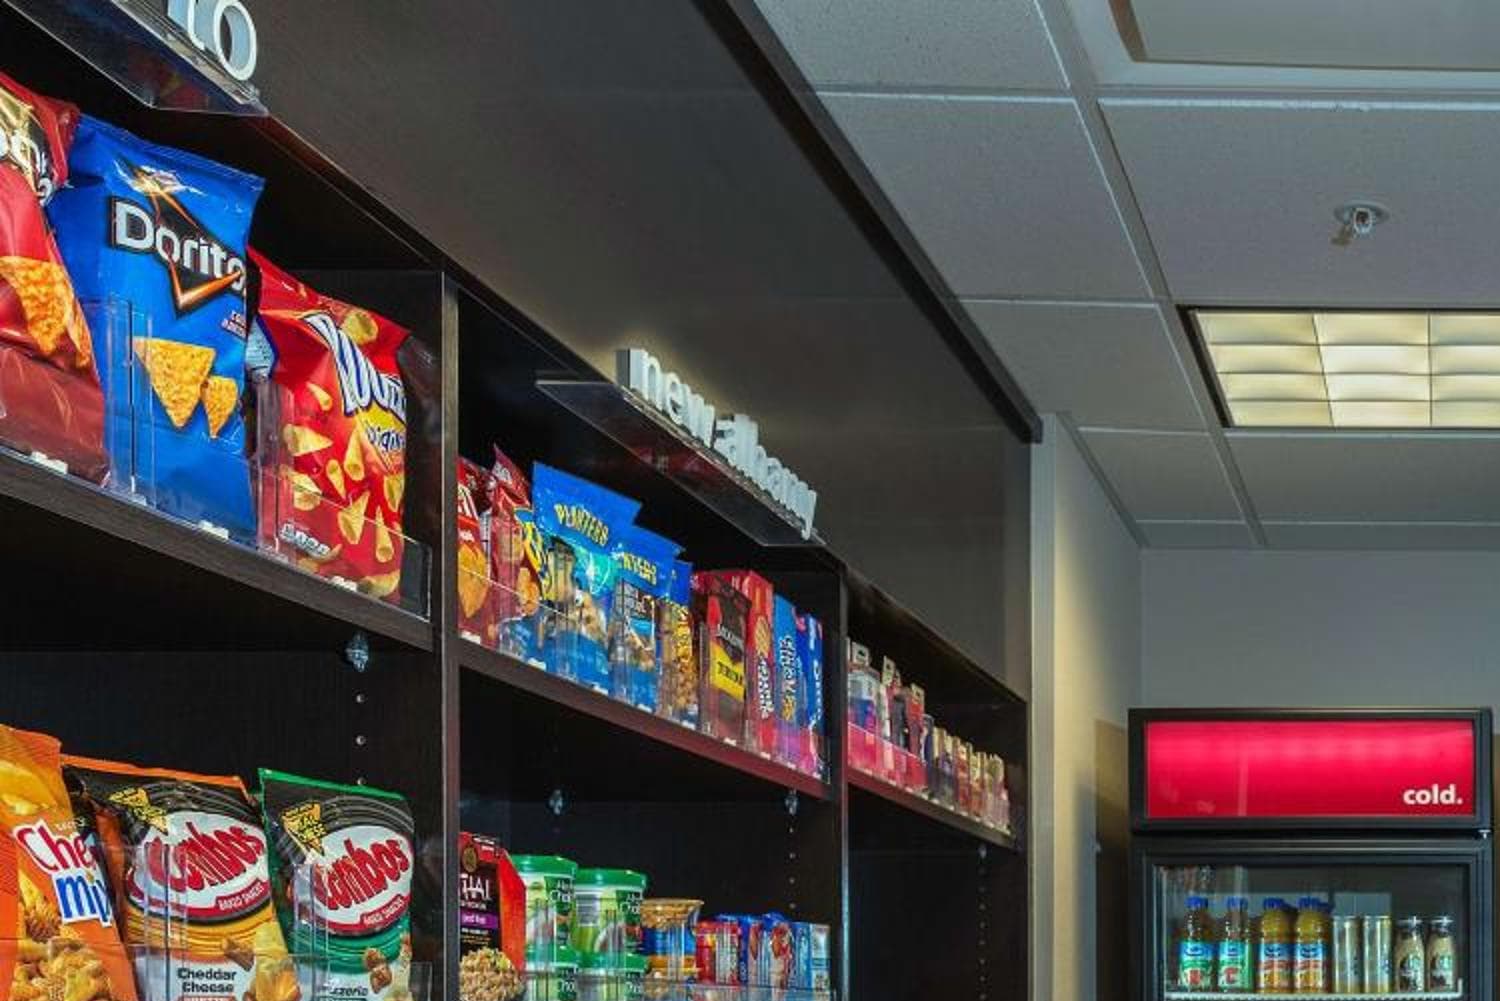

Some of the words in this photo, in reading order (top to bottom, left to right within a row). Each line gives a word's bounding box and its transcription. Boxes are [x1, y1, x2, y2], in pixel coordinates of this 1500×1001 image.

[114, 200, 247, 293] Dorito
[1403, 783, 1463, 805] cold.
[177, 967, 237, 981] Cheddar
